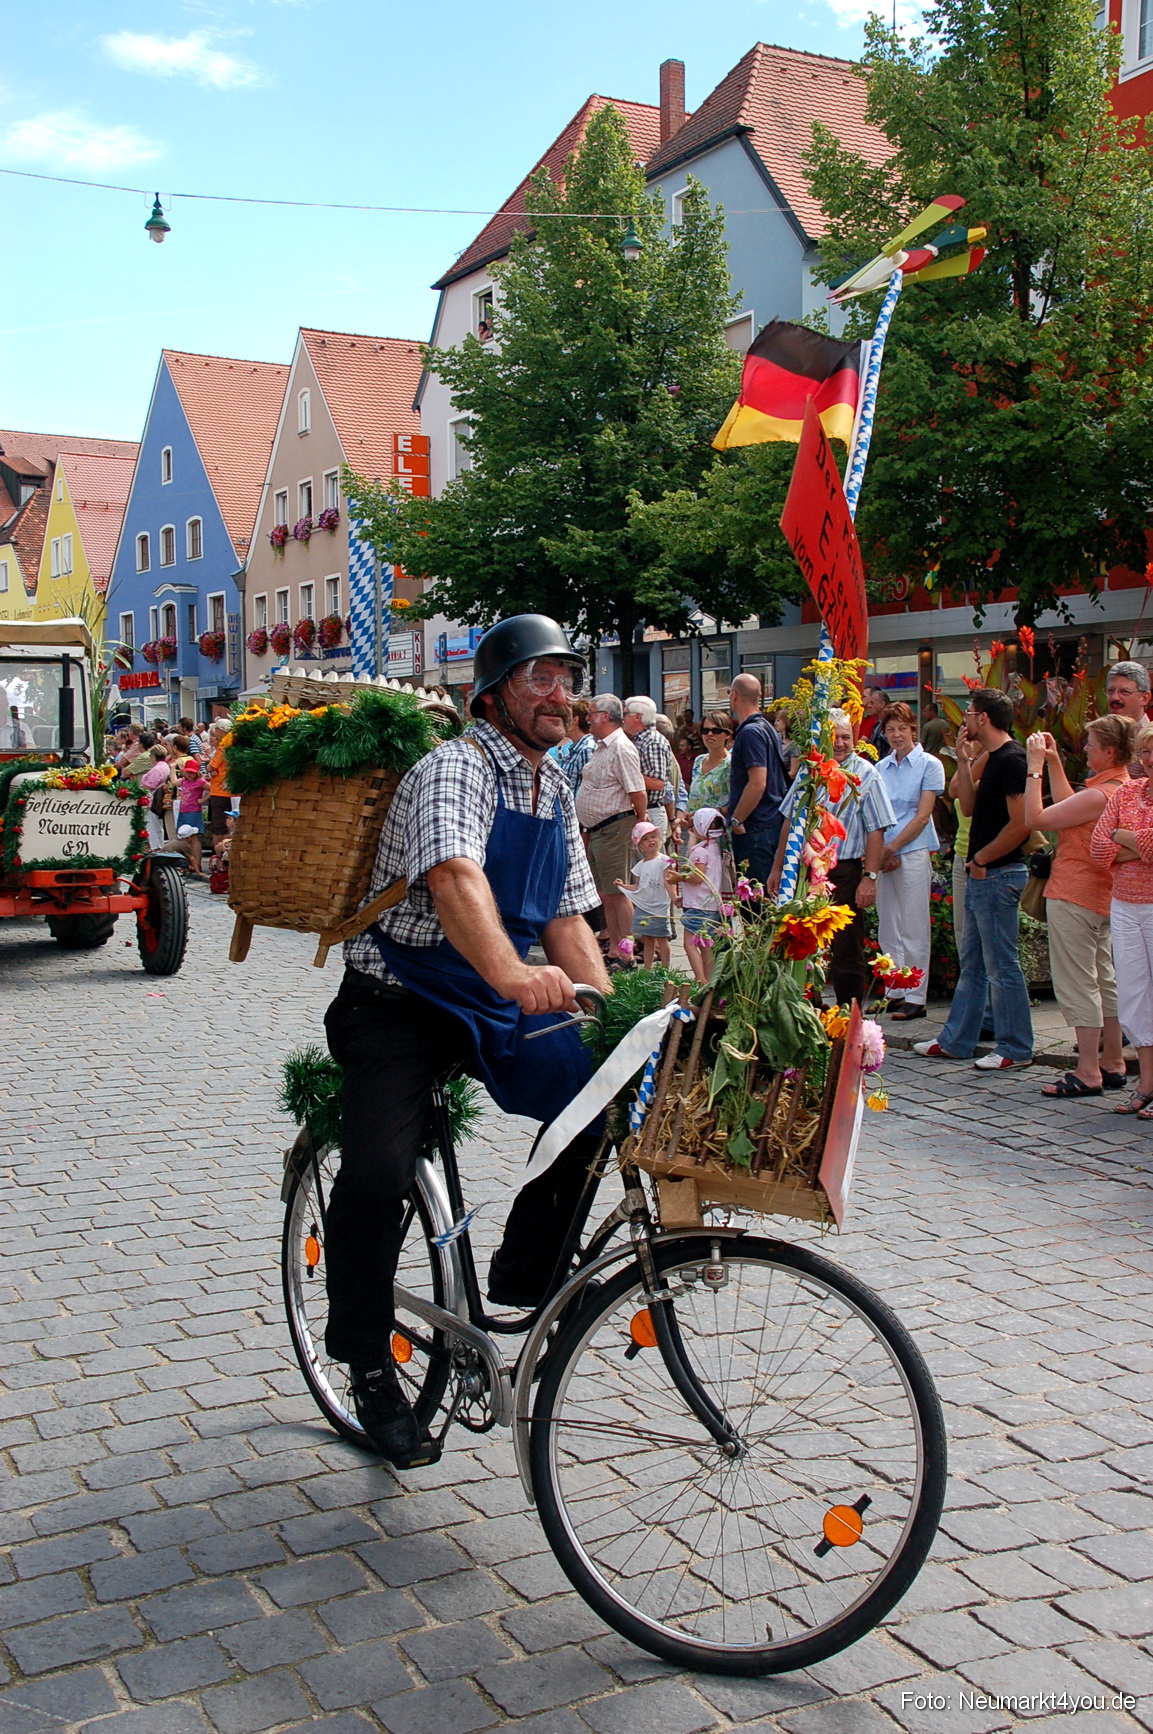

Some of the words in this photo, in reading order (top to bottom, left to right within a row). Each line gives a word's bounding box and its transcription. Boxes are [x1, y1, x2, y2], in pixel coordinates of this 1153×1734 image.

[816, 427, 836, 501] Der
[229, 625, 239, 670] WITTL
[26, 796, 133, 816] Geflügelzüchter
[38, 818, 111, 836] Neumarkt
